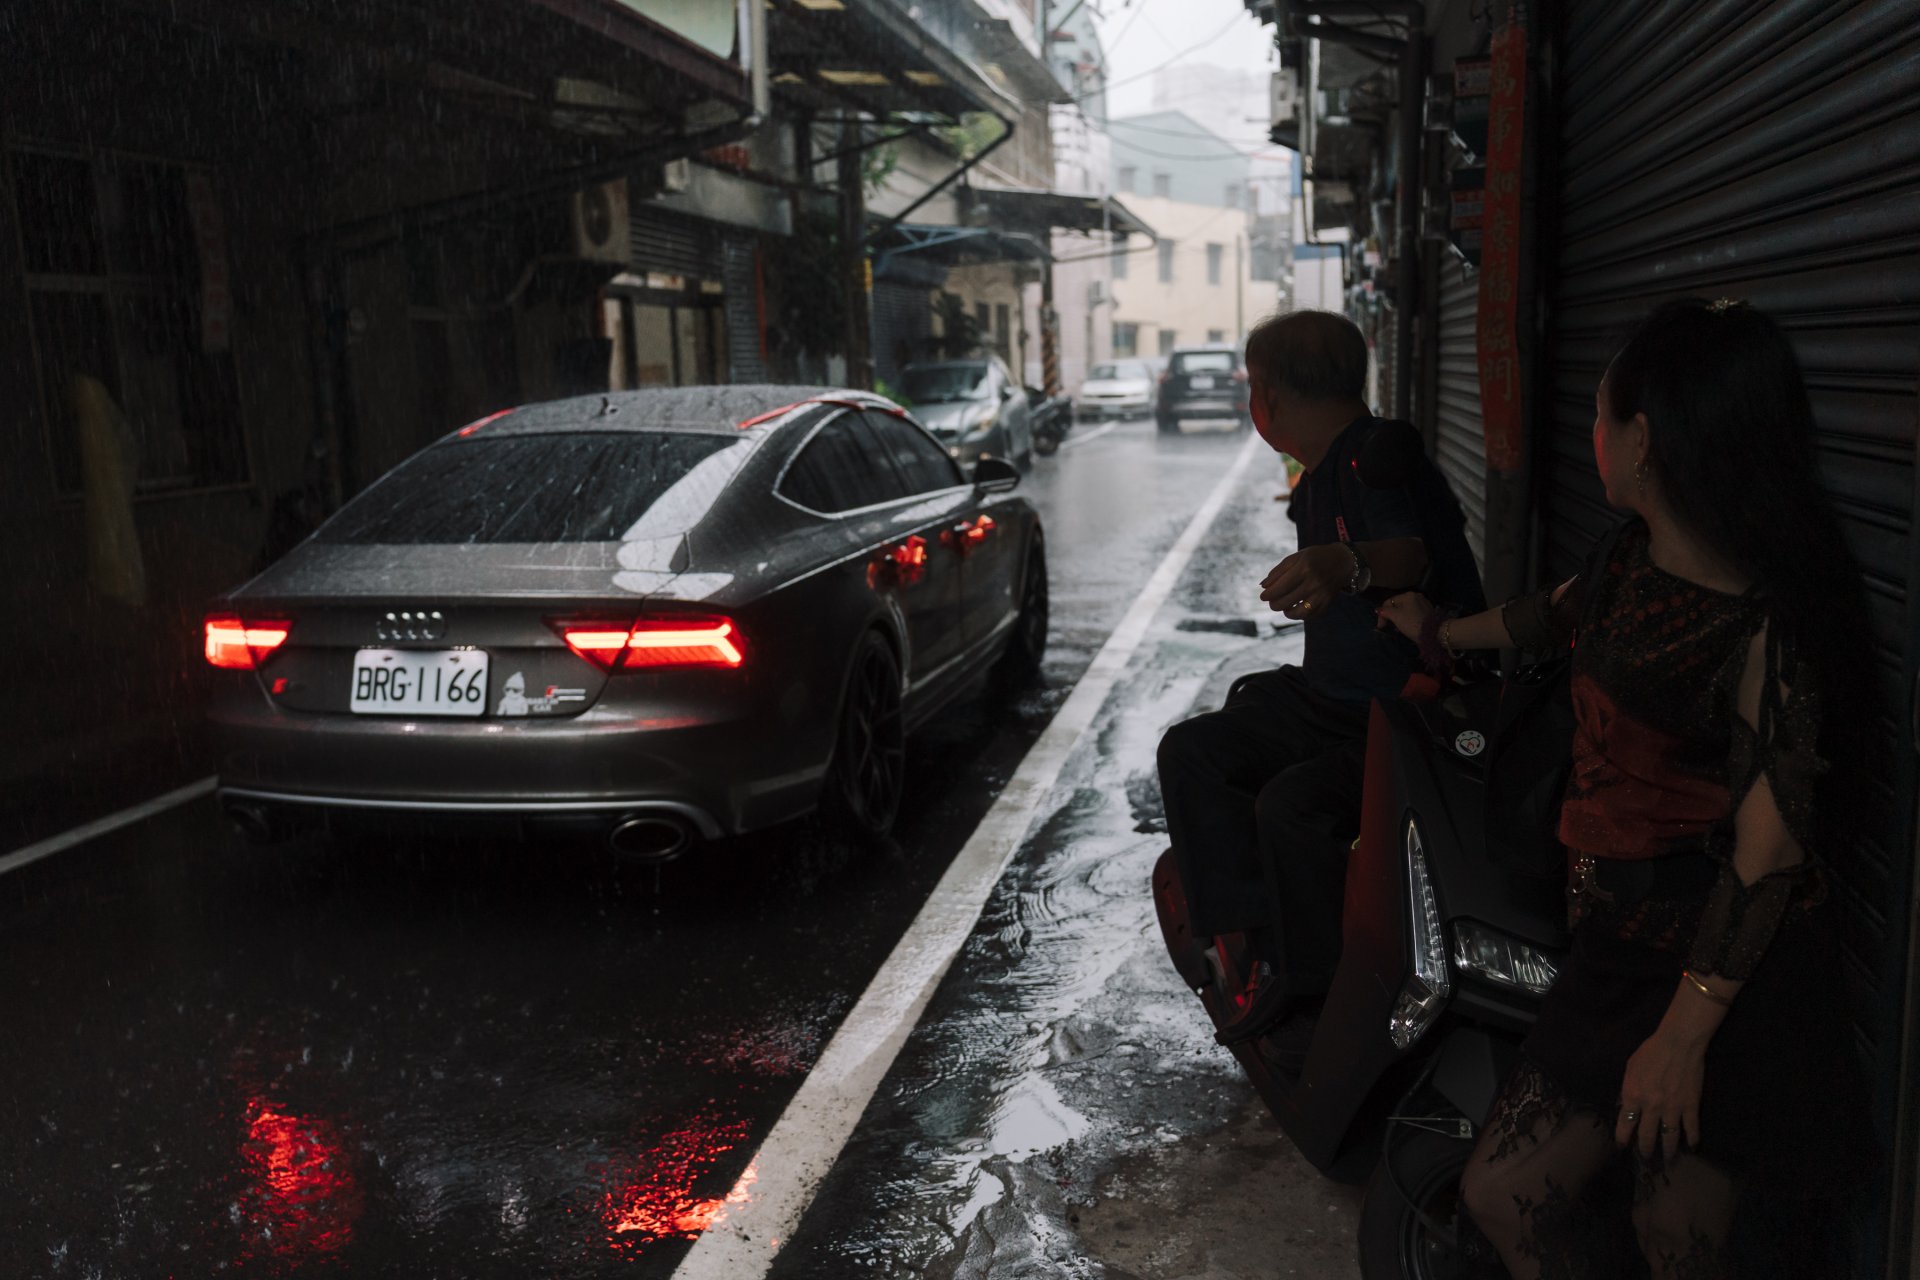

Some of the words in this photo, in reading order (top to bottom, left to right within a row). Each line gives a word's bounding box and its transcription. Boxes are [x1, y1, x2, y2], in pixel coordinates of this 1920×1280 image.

[1482, 48, 1516, 401] 萬事如意福臨門
